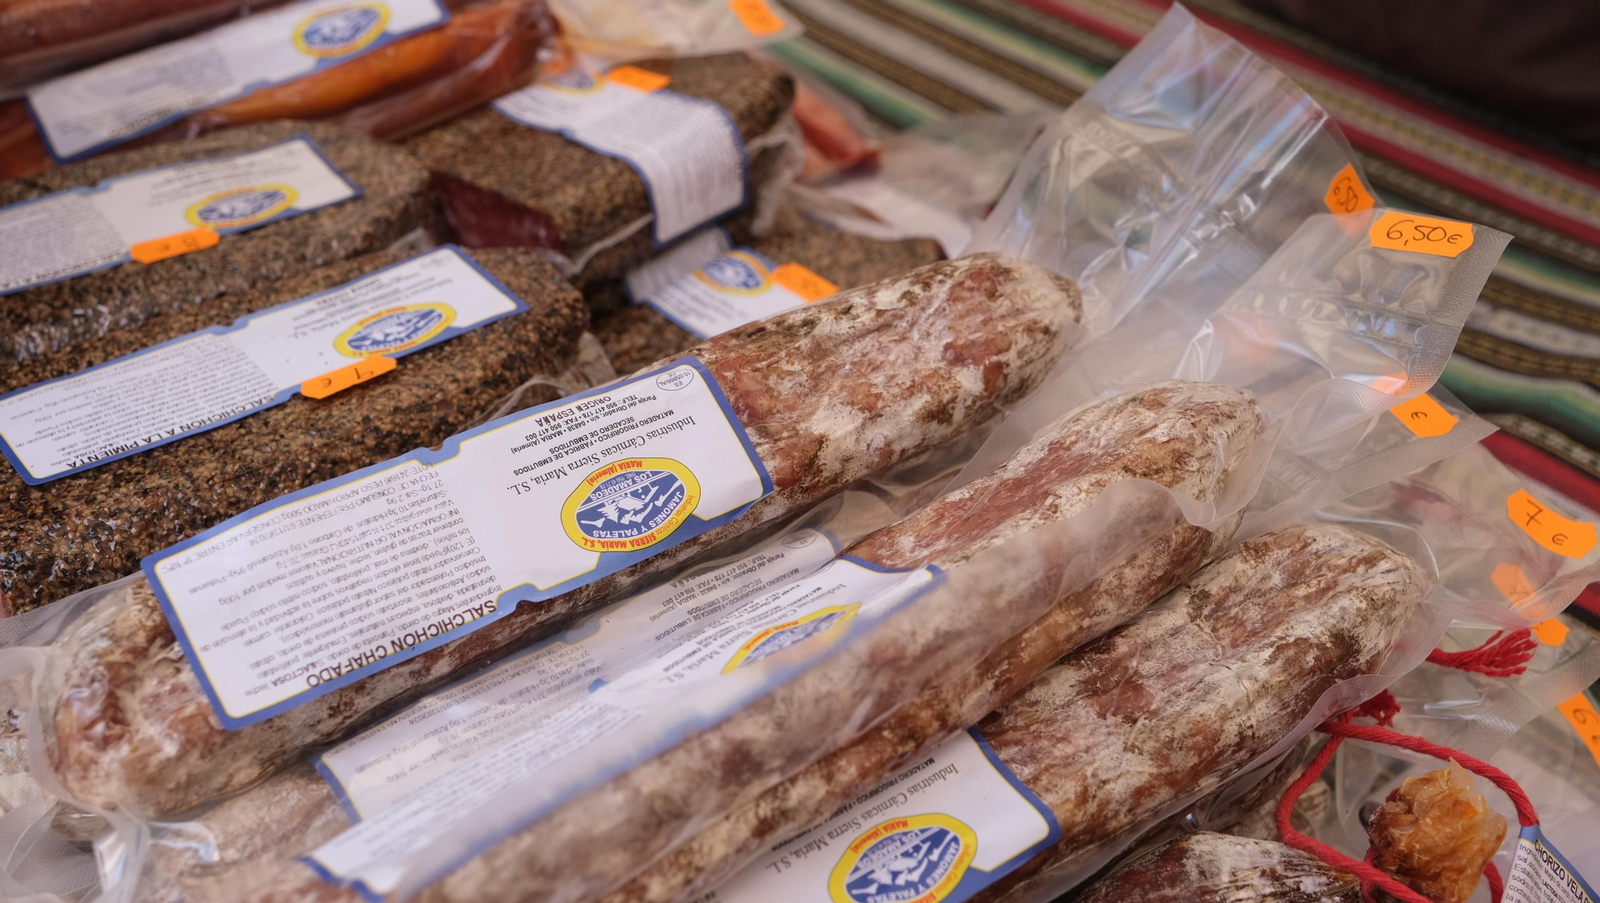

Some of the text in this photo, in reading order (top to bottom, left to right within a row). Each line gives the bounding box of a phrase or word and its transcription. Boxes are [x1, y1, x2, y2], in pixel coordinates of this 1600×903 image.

[1386, 218, 1463, 246] 6,50€
[604, 400, 617, 410] 950
[626, 399, 637, 409] del
[636, 391, 656, 406] Paraje
[533, 394, 611, 427] ORIGEN ESPAÑA
[580, 409, 593, 420] 178
[588, 414, 600, 424] s/n
[592, 405, 605, 415] 417
[599, 403, 627, 420] Obrador,
[638, 407, 674, 427] MATADERO
[536, 426, 549, 436] 417
[548, 415, 634, 454] SECADERO DE EMBUTIDOS
[549, 421, 562, 431] 950
[566, 419, 586, 432] 04838
[141, 432, 162, 445] LA
[524, 431, 537, 441] 003
[64, 439, 139, 470] PIMIENTA
[506, 413, 695, 498] Industrias Cárnicas Sierra María, S.L.
[552, 451, 562, 461] DE
[562, 438, 594, 457] FÁBRICA
[512, 455, 552, 477] EMBUTIDOS
[617, 459, 643, 471] MARÍA
[354, 467, 438, 508] FECHA DE CONSUMO
[358, 477, 383, 494] PESO
[588, 470, 652, 501] LOS AMADEOS
[592, 491, 682, 538] JAMONES Y PALETAS
[1526, 499, 1568, 546] 7 €
[224, 514, 282, 546] CONSERVAR
[299, 497, 454, 562] Valor energético 371 Grasas
[307, 526, 342, 548] Carbono
[406, 527, 432, 544] trazas
[596, 539, 628, 551] MARÍA,
[627, 531, 657, 549] SIERRA
[192, 540, 225, 560] ENTRE
[765, 551, 785, 565] Paraje
[320, 560, 346, 577] huevo
[372, 563, 402, 581] efectos
[401, 556, 421, 570] tener
[724, 566, 737, 576] 417
[755, 559, 767, 570] del
[333, 573, 373, 597] negativos
[409, 566, 453, 592] Potenciador
[765, 566, 800, 587] MATADERO
[216, 590, 241, 608] 100g
[239, 583, 256, 597] por
[310, 589, 334, 606] sobre
[372, 589, 396, 605] sabor
[395, 584, 409, 596] del
[672, 590, 685, 601] 417
[686, 577, 762, 617] SECADERO DE EMBUTIDOS
[690, 613, 700, 622] DE
[653, 616, 692, 642] EMBUTIDOS
[304, 596, 498, 690] SALCHICHÓN CHAFADO
[505, 659, 545, 682] CONSUMO
[895, 756, 935, 781] MATADERO
[762, 762, 959, 877] Industrias Cárnicas Sierra María, S.L.
[855, 828, 922, 870] LOS AMADEOS
[1534, 839, 1566, 881] CHORIZO
[866, 841, 958, 903] JAMONES Y PALETAS
